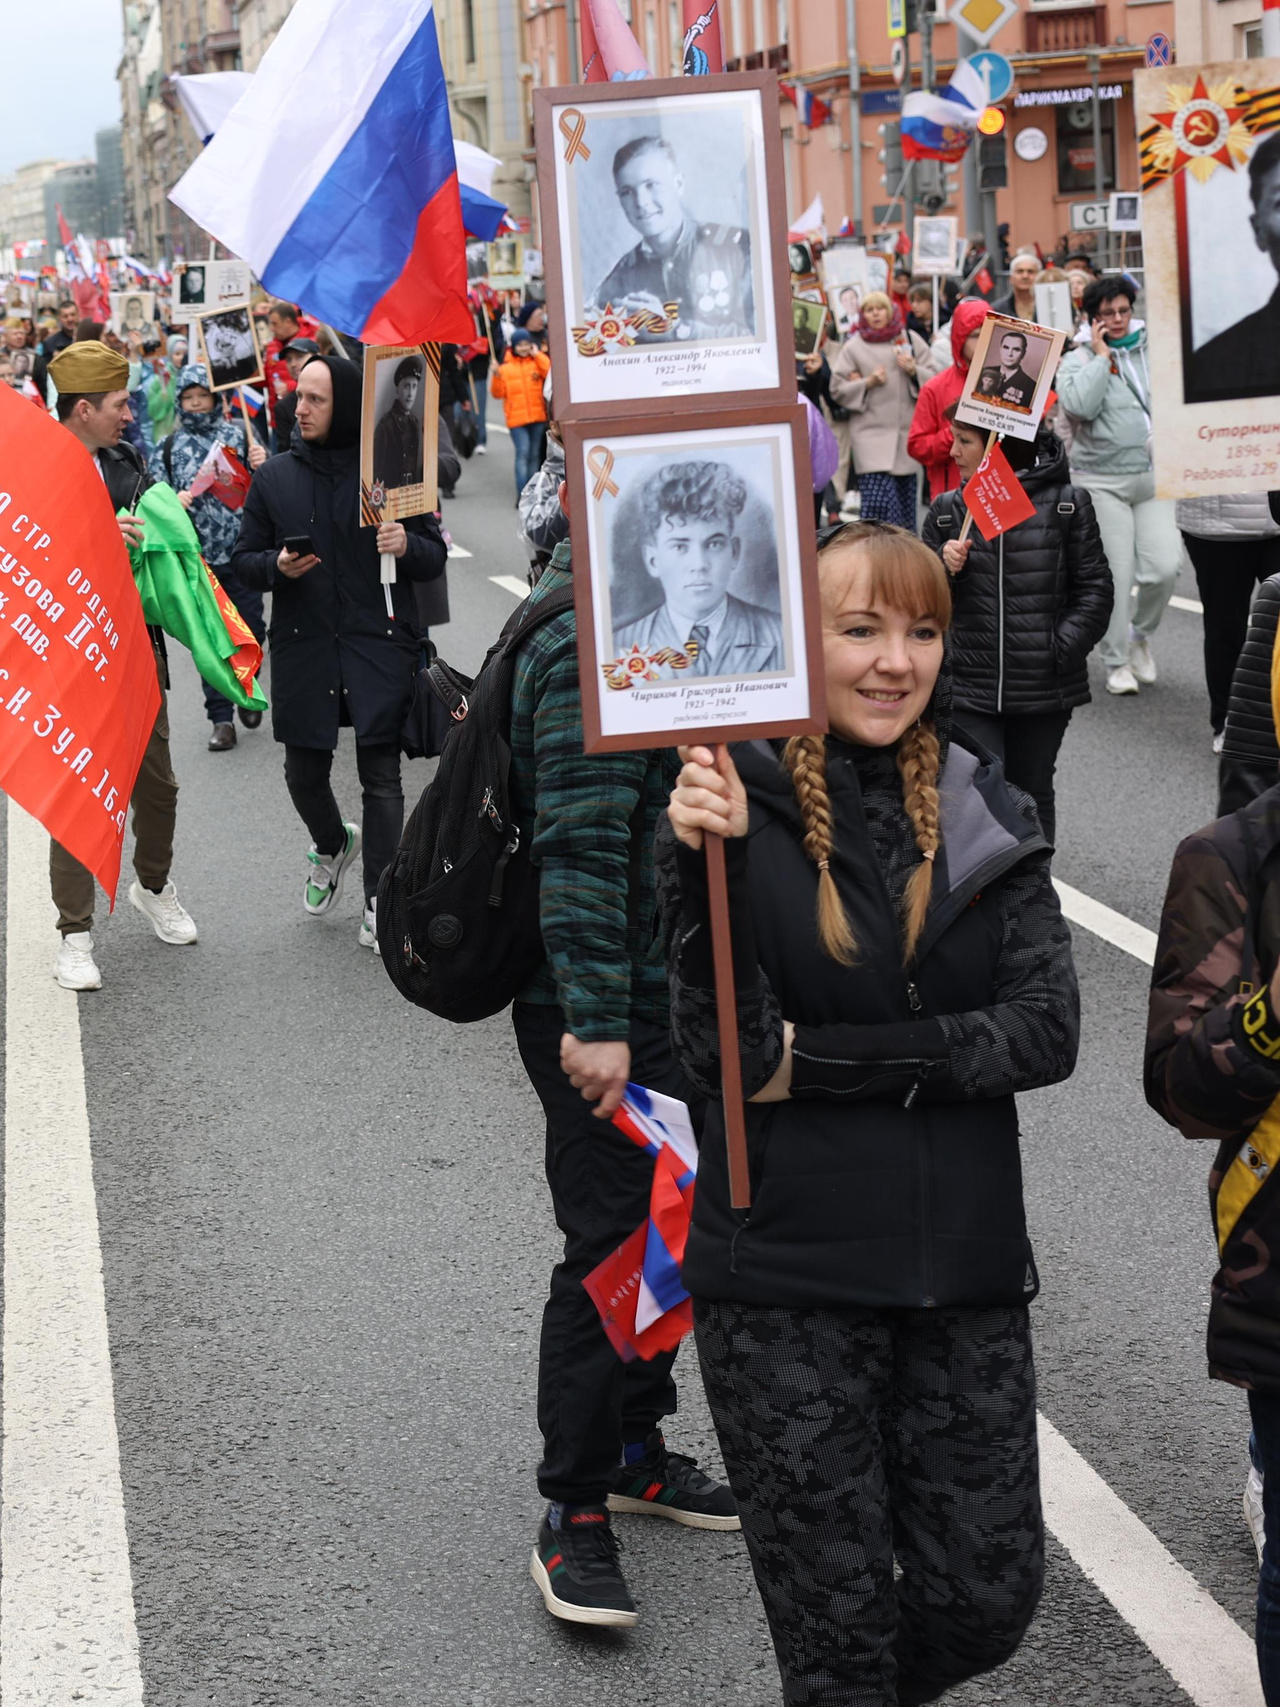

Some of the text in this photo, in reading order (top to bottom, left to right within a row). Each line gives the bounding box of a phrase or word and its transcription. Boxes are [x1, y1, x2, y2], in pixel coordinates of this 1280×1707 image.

[1013, 84, 1122, 107] ПАРИКМАХЕРКАЯ
[600, 345, 761, 367] Анохин Александр Яковлевич
[631, 680, 788, 702] Чириков Григорий Иванович
